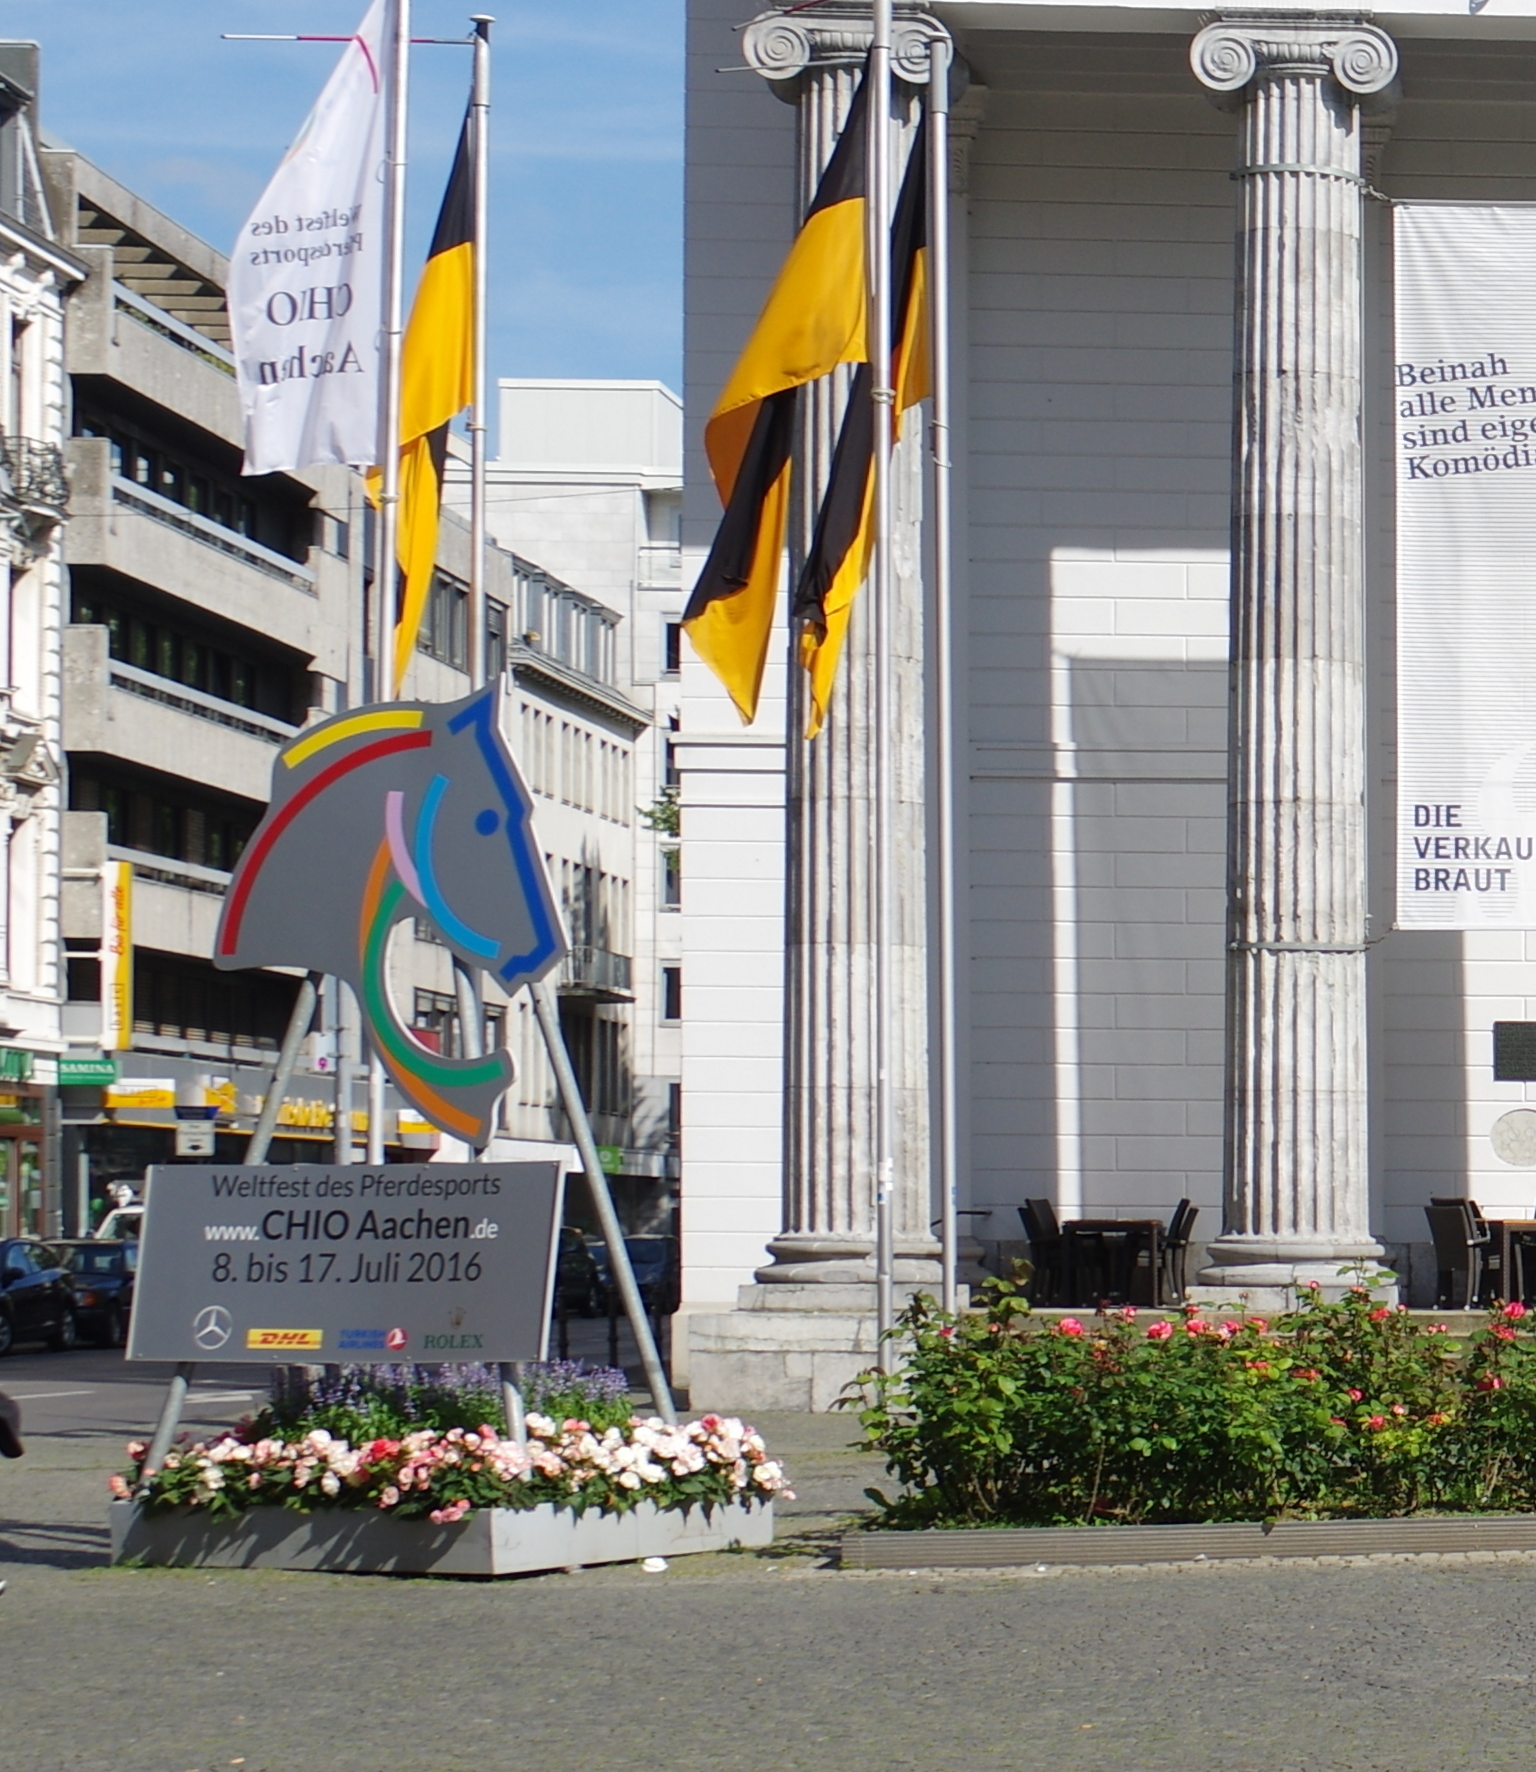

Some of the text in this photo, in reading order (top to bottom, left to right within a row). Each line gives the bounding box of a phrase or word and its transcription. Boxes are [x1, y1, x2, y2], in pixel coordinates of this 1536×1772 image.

[1394, 352, 1510, 387] Beinah
[1399, 392, 1457, 418] alle
[1402, 419, 1471, 450] sind
[1414, 804, 1462, 828] DIE
[1414, 868, 1511, 891] BRAUT
[212, 1173, 501, 1200] Weltfest des Pferdesports
[212, 1251, 482, 1283] 8. bis 17. Juli 2016
[259, 1332, 311, 1345] DHL
[423, 1334, 483, 1349] ROLEX
